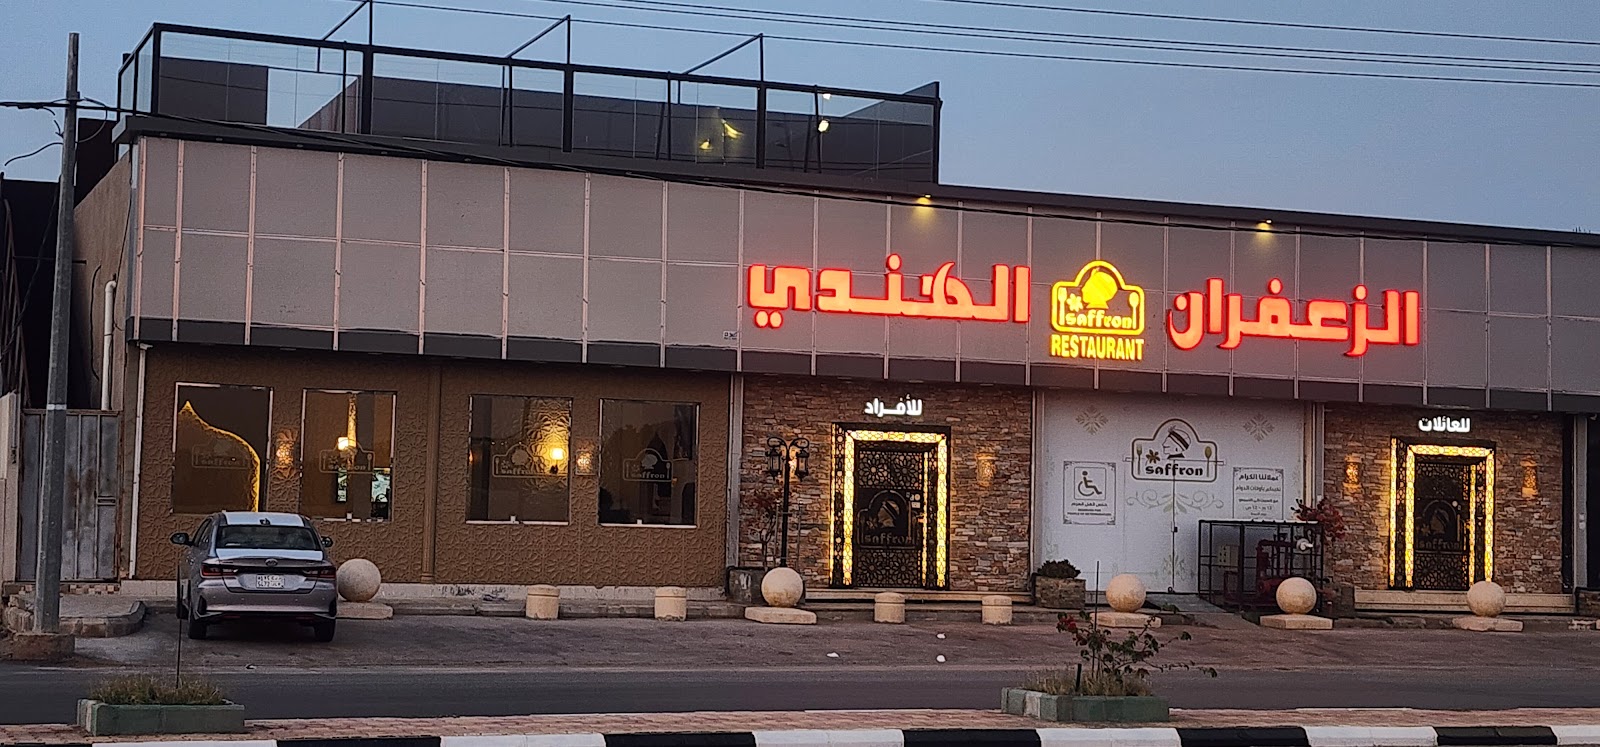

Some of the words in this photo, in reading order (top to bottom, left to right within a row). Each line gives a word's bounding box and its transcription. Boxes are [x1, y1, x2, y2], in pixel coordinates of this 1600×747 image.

[748, 253, 1031, 329] الهندي
[1065, 309, 1133, 329] saffron
[1167, 277, 1420, 357] الزعفران
[1051, 334, 1144, 360] RESTAURANT
[863, 393, 923, 418] للأفراد
[1418, 415, 1471, 433] للعائلات
[1145, 463, 1204, 476] saffron
